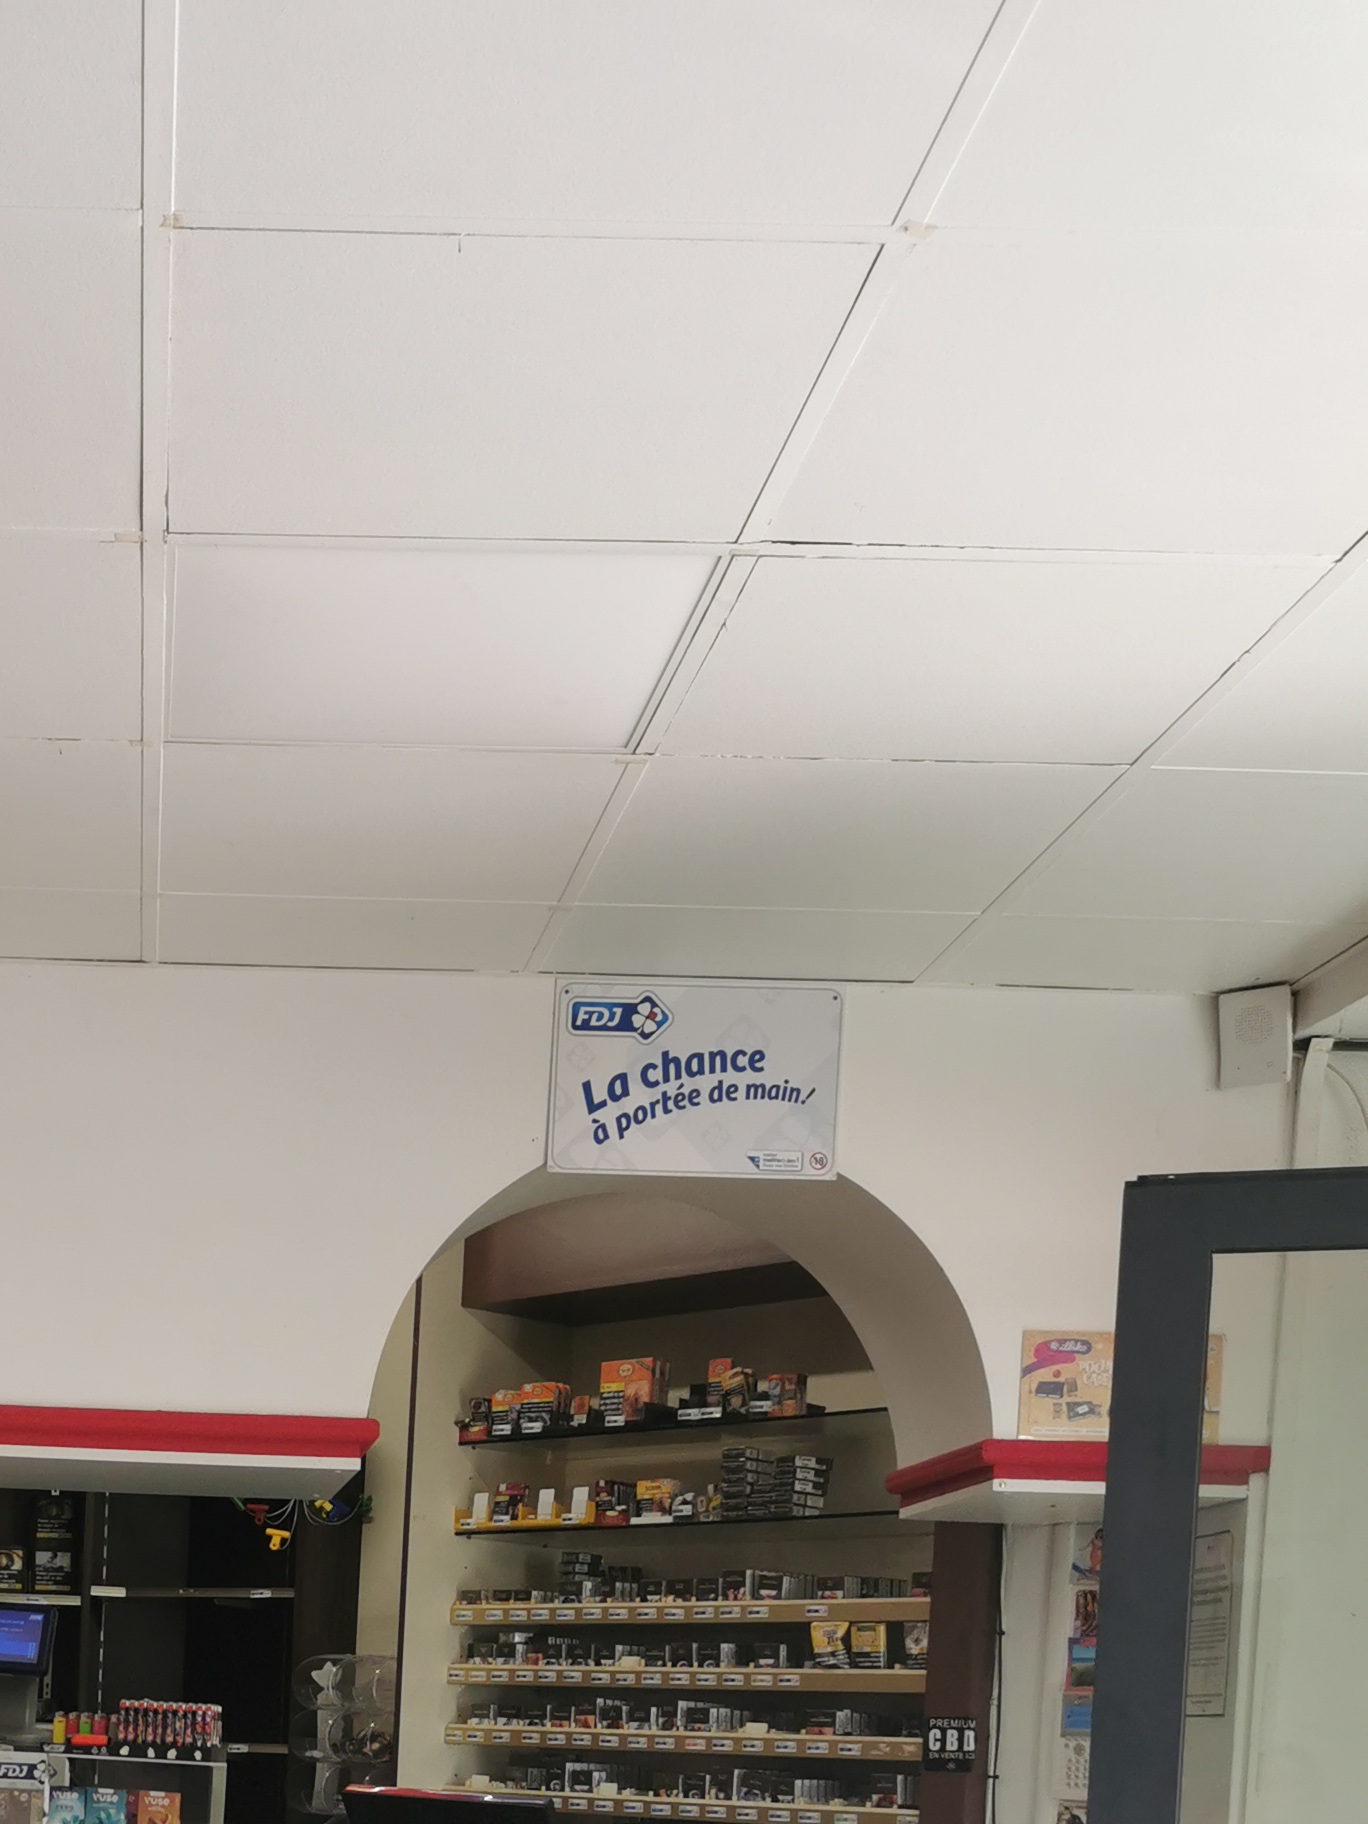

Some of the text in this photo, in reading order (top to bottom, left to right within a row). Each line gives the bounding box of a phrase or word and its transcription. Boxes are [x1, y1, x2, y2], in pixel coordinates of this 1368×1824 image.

[574, 1005, 624, 1028] FDJ
[581, 1049, 766, 1115] La chance
[591, 1118, 610, 1145] à
[615, 1083, 701, 1140] portée
[707, 1079, 738, 1103] de
[929, 1718, 976, 1728] PREMIUM
[928, 1728, 976, 1751] CBD
